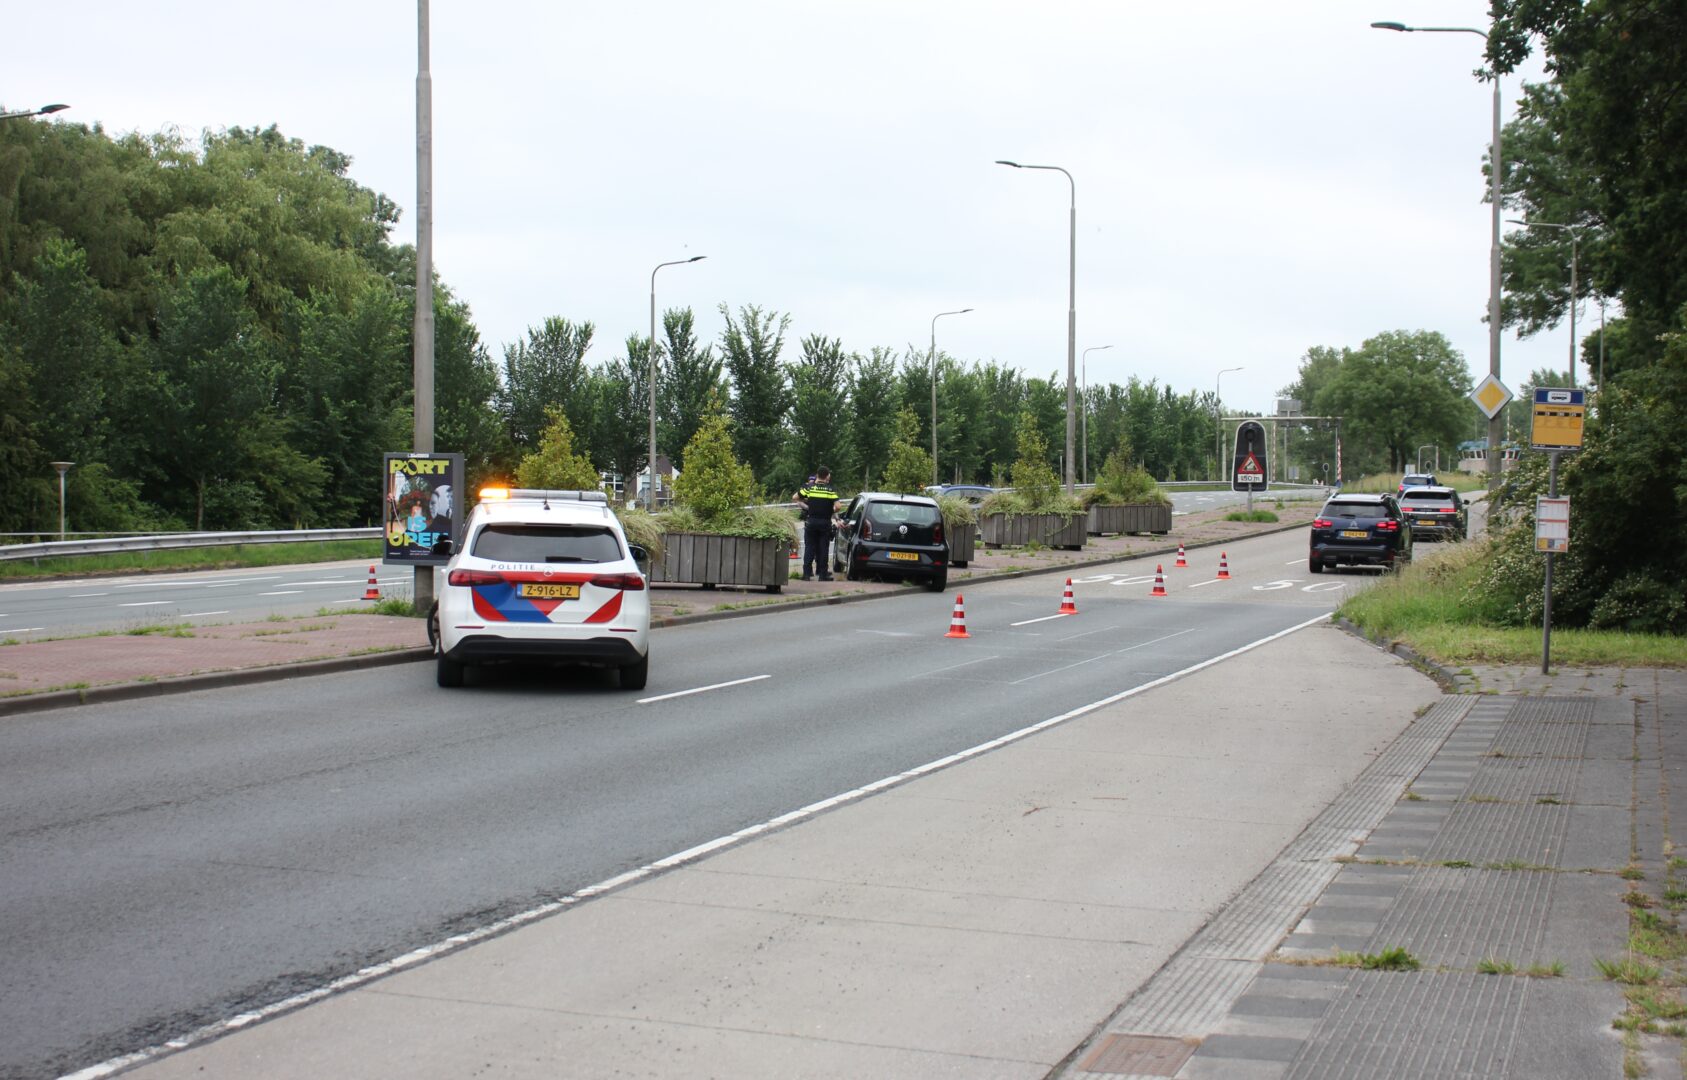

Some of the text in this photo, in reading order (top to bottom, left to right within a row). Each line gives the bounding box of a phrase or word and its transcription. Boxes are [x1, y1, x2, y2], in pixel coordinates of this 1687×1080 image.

[389, 459, 449, 475] PORT
[407, 516, 427, 532] IS
[1071, 574, 1168, 586] 50
[1252, 579, 1347, 593] 50
[526, 586, 573, 596] Z-916-LZ
